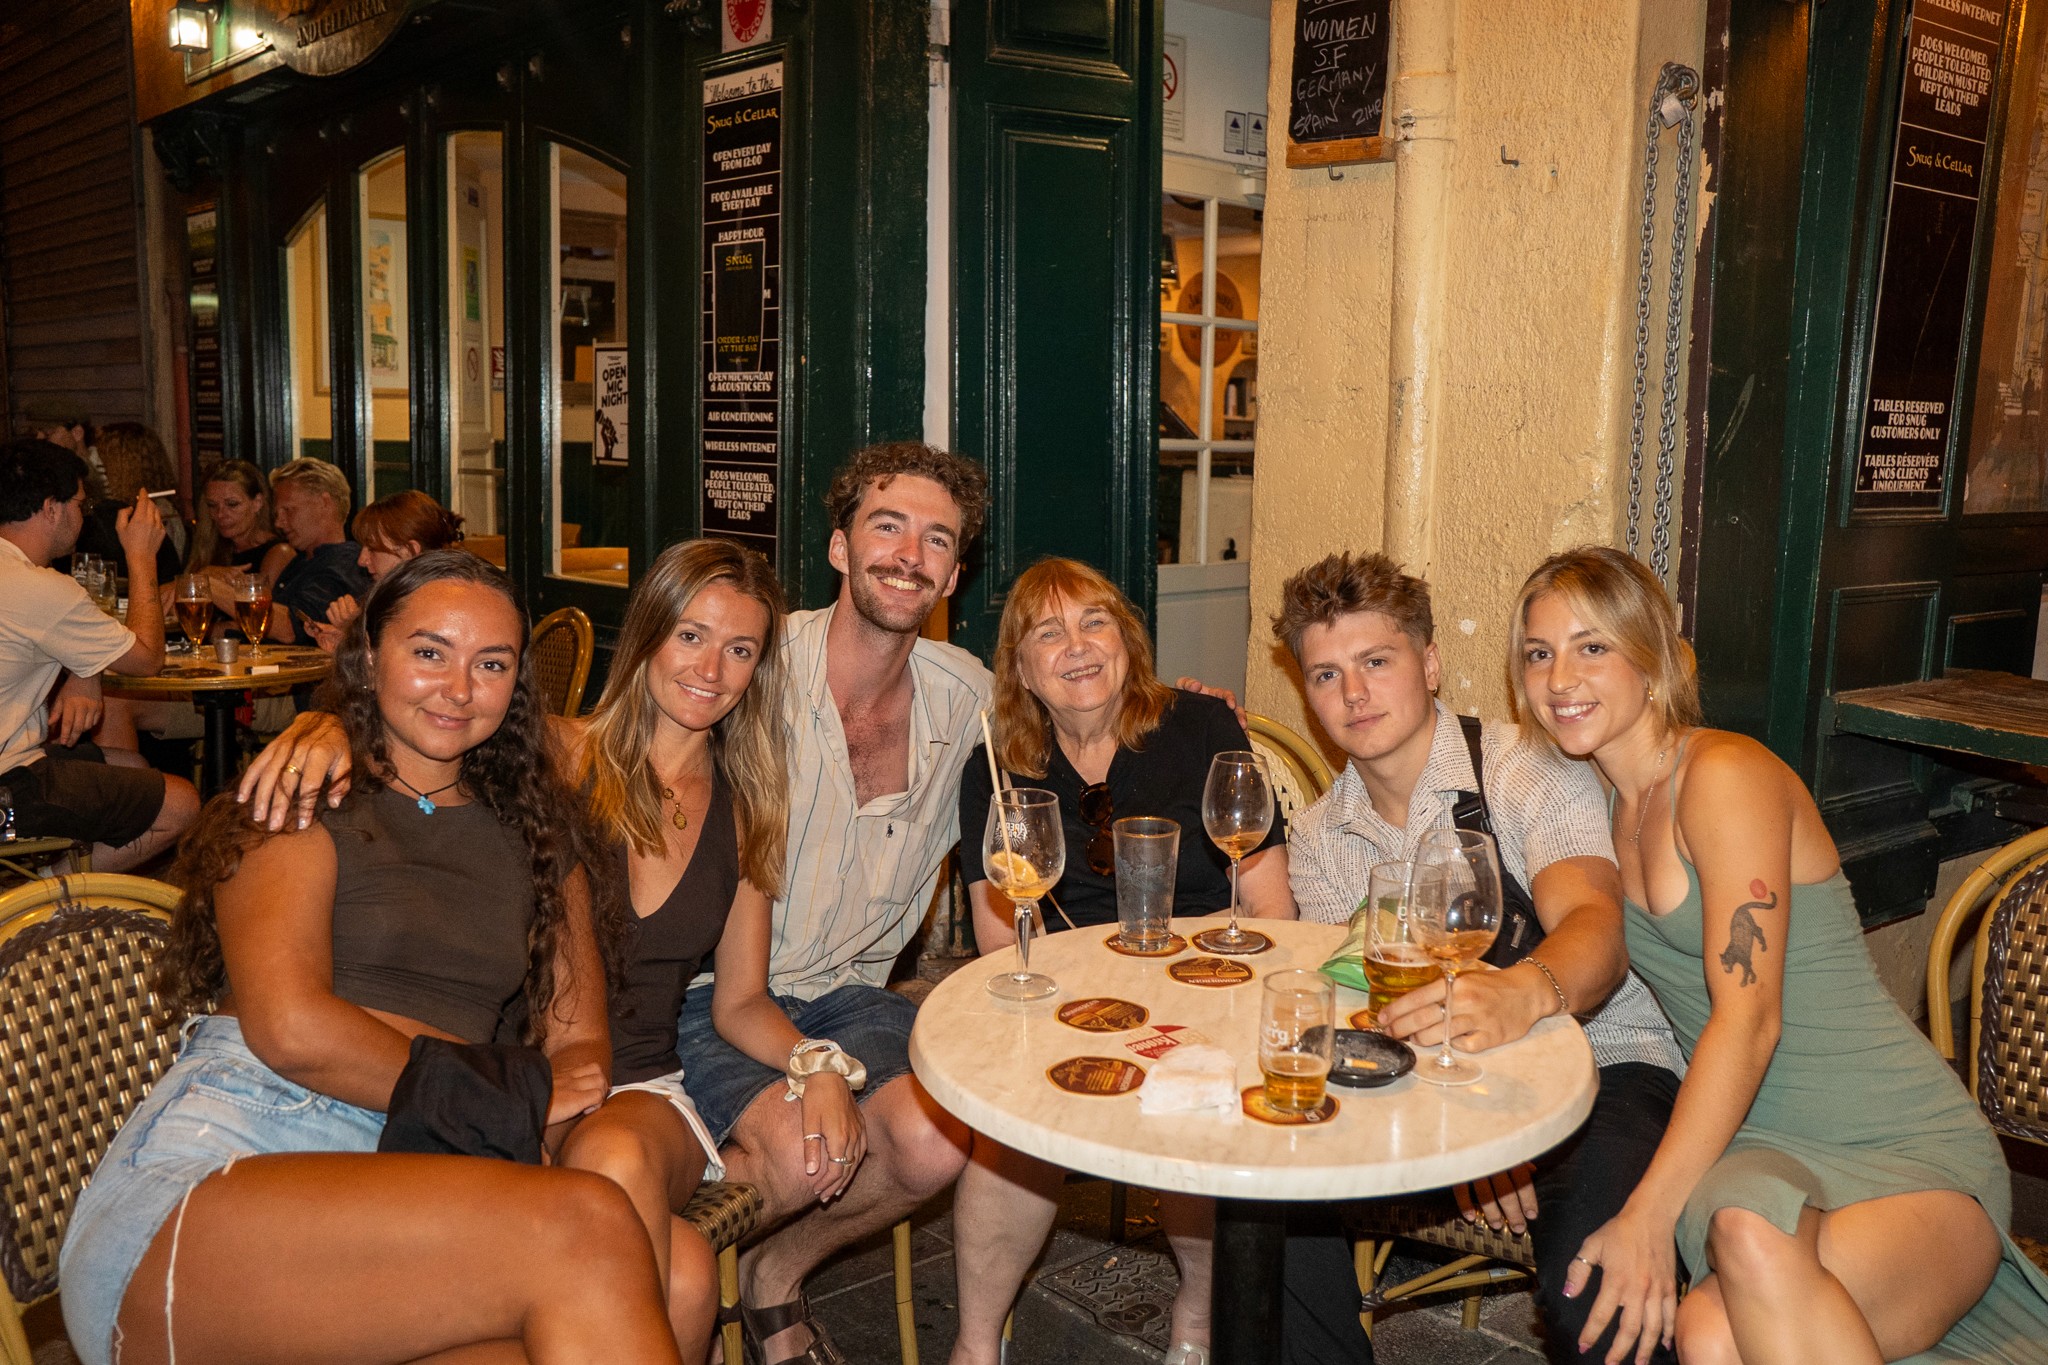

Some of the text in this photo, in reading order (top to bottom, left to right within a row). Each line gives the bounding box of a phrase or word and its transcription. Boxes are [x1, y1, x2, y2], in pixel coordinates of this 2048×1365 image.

[1961, 1, 2001, 26] INTERNET
[1303, 12, 1376, 42] WOMEN
[1920, 34, 1988, 68] DOGS WELCOMED,
[1912, 46, 1992, 84] PEOPLE TOLERATED,
[746, 76, 757, 94] to
[757, 73, 774, 92] the
[1297, 62, 1376, 101] GERMANY
[1914, 62, 1989, 95] CHILDREN MUST BE
[1920, 79, 1979, 107] KEPT ON THEIR
[1935, 97, 1961, 116] LEADS
[734, 110, 742, 124] &
[1294, 105, 1340, 136] SPAIN
[713, 142, 772, 162] OPEN EVERY DAY
[721, 154, 762, 171] FROM 12:00
[1934, 152, 1942, 168] &
[710, 184, 773, 203] FOOD AVAILABLE
[721, 196, 761, 212] EVERY DAY
[718, 227, 765, 242] HAPPY HOUR
[725, 253, 752, 266] SNUG
[717, 335, 740, 345] ORDER
[730, 344, 744, 352] THE
[745, 343, 757, 352] BAR
[602, 365, 627, 381] OPEN
[742, 371, 774, 382] MONDAY
[606, 380, 623, 394] MIC
[710, 382, 771, 392] & ACOUSTIC SETS
[601, 392, 628, 408] NIGHT
[1873, 399, 1945, 414] TABLES RESERVED
[707, 411, 774, 423] AIR CONDITIONING
[1888, 413, 1927, 427] FOR SNUG
[1870, 425, 1941, 440] CUSTOMERS ONLY
[704, 440, 776, 454] WIRELESS INTERNET
[1864, 451, 1939, 468] TABLES RÉSERVÉES
[710, 470, 770, 483] DOGS WELCOMED,
[1879, 467, 1896, 480] NOS
[1896, 467, 1929, 480] CLIENTS
[705, 479, 775, 494] PEOPLE TOLERATED,
[1873, 480, 1927, 491] UNIQUEMENT
[707, 488, 773, 503] CHILDREN MUST BE
[714, 498, 766, 512] KEPT ON THEIR
[728, 509, 751, 521] LEADS
